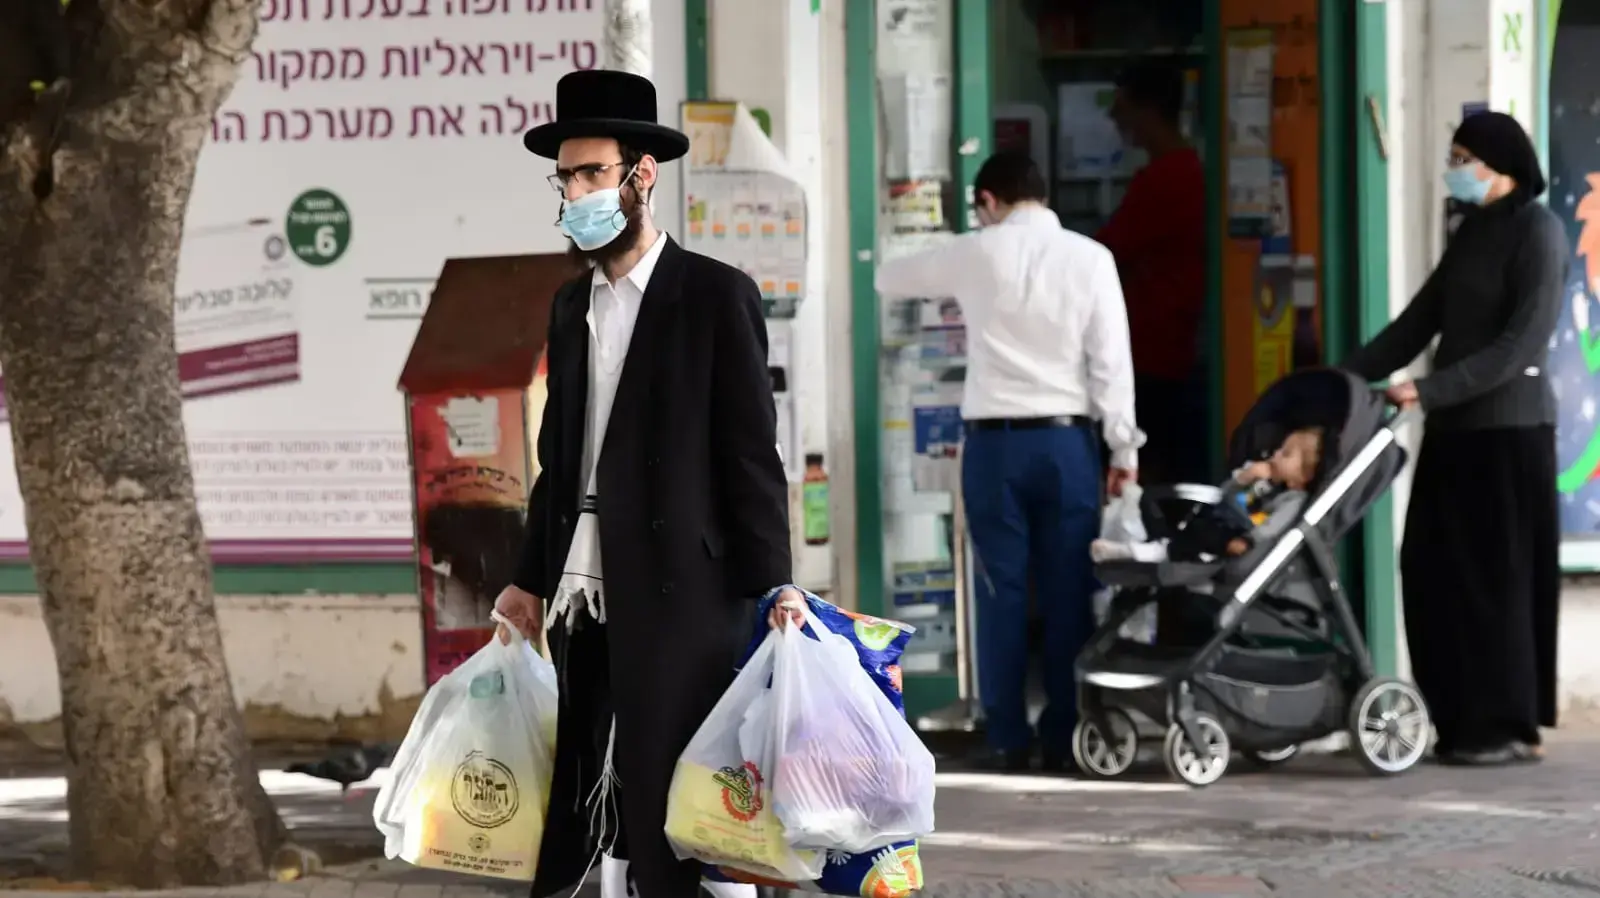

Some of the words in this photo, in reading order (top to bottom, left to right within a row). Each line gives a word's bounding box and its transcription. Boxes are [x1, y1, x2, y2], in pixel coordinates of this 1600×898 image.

[260, 105, 394, 142] מערכת
[407, 103, 466, 138] את
[315, 225, 338, 258] 6
